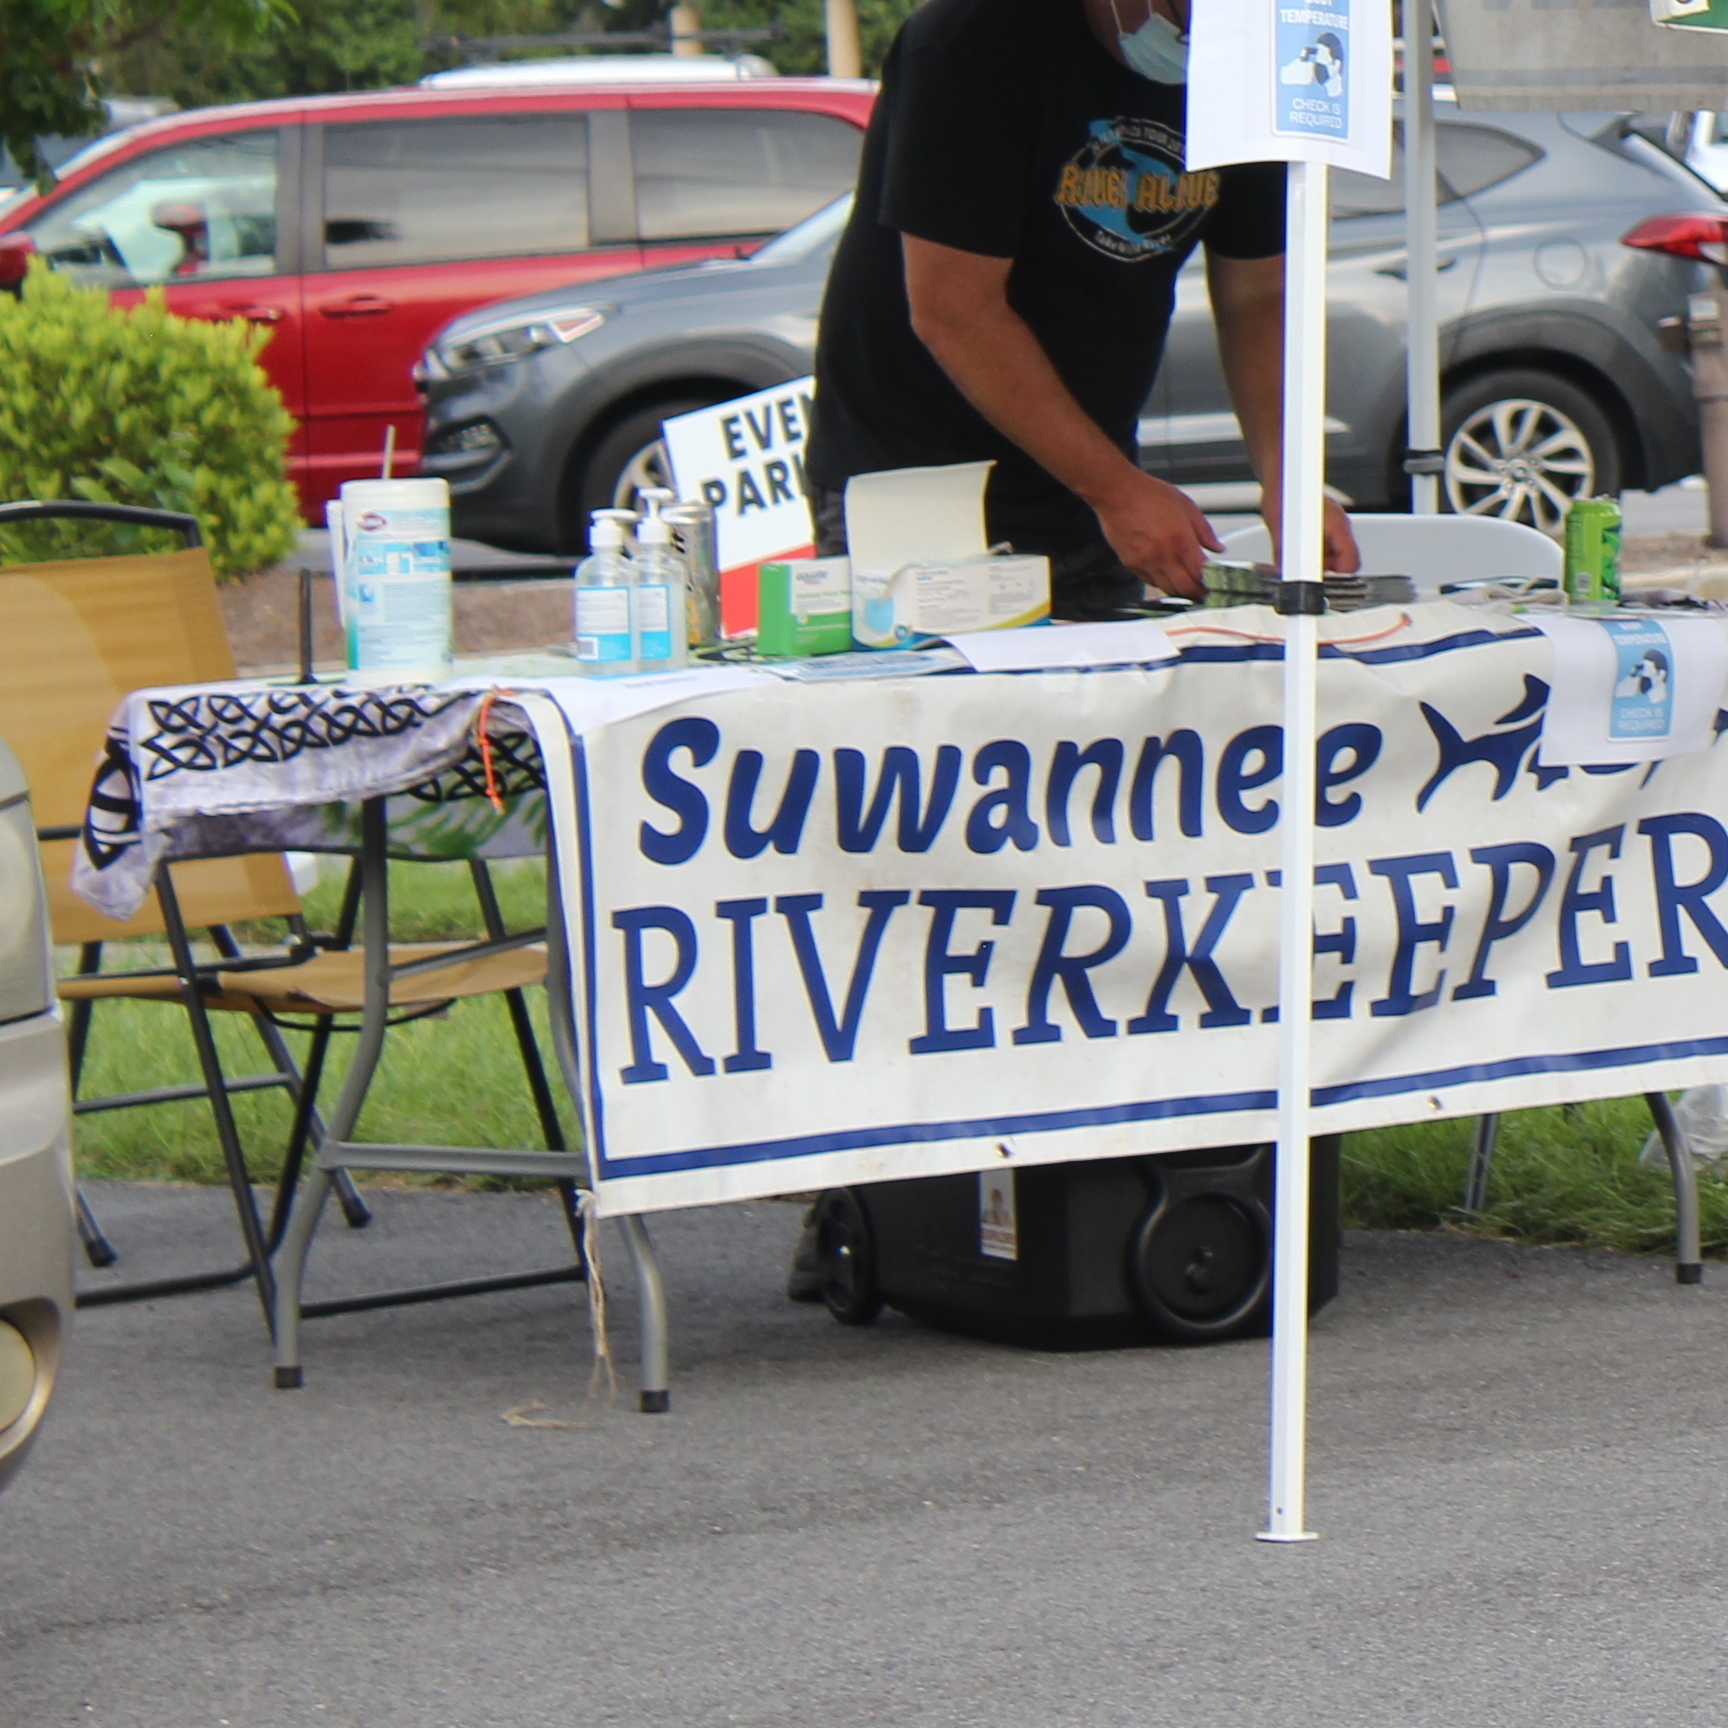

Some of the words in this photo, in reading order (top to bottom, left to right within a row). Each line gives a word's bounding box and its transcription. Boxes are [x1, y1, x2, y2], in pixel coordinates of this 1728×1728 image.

[1278, 8, 1349, 30] TEMPERATURE
[1292, 97, 1330, 113] CHECK
[1332, 103, 1341, 115] IS
[1289, 111, 1343, 129] REQUIRED
[639, 715, 1383, 867] Suwannee
